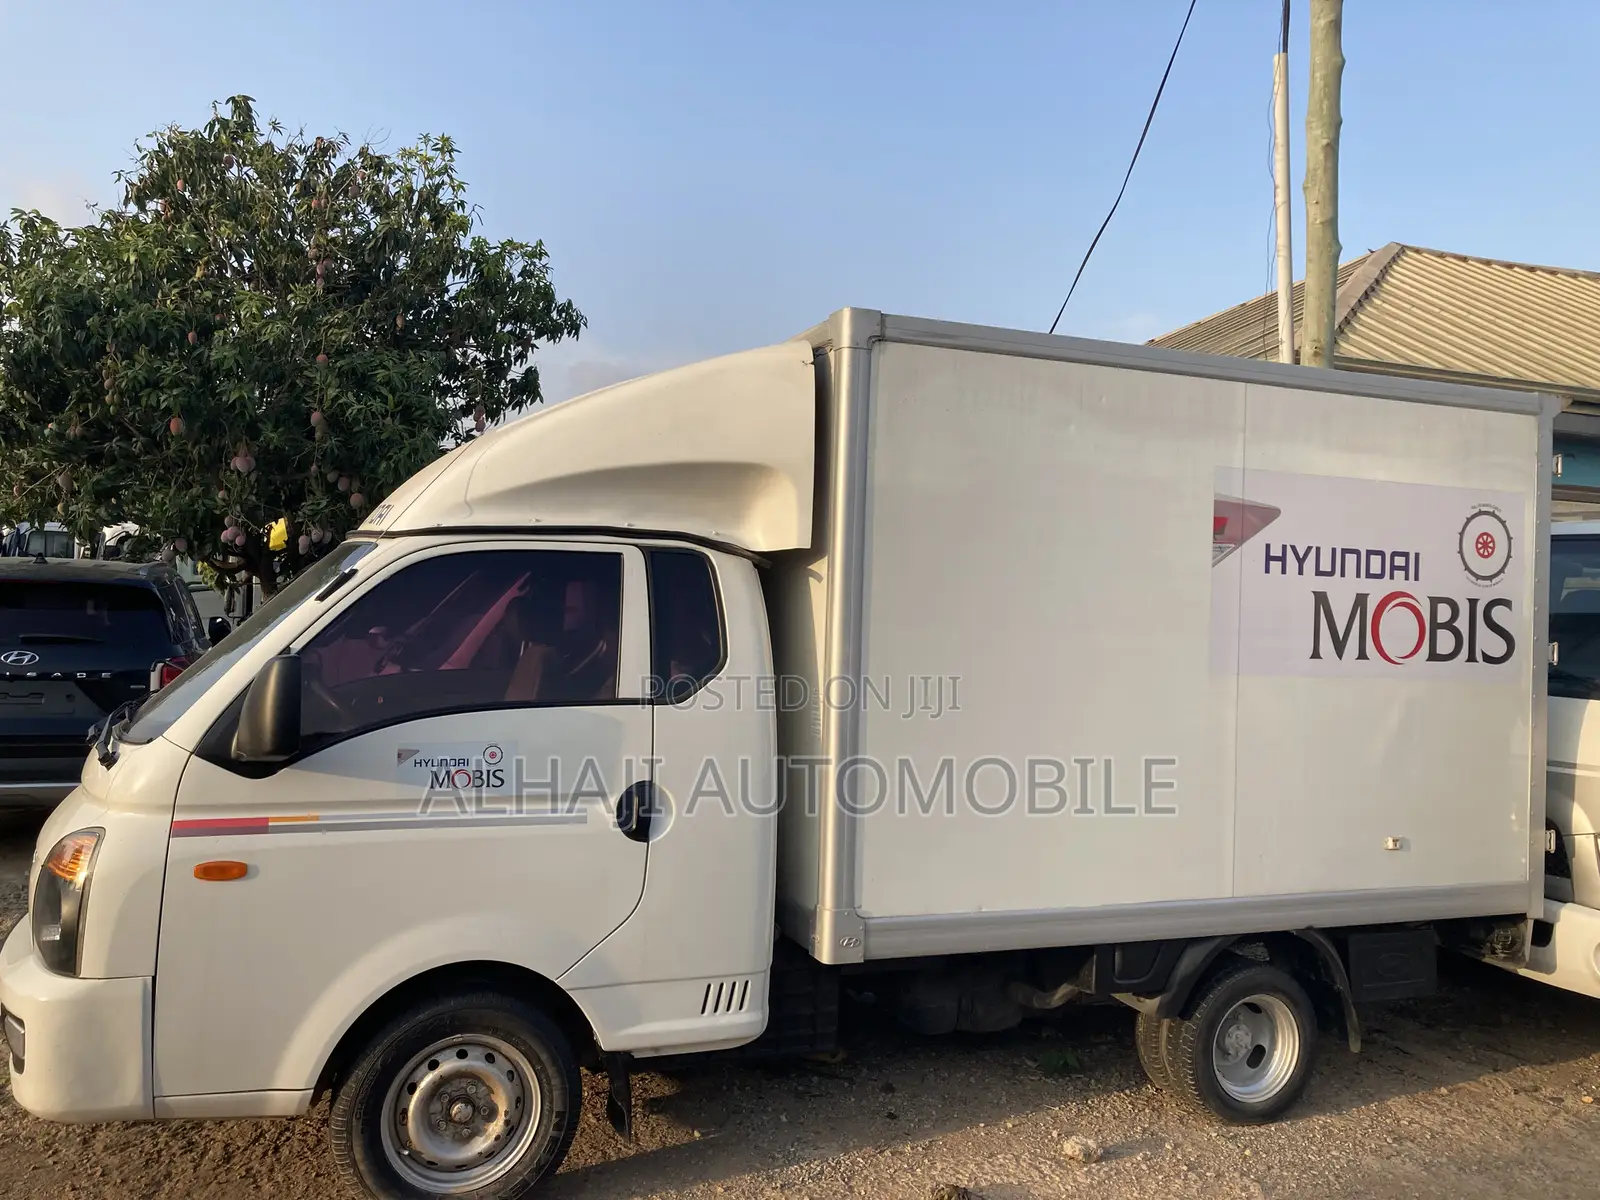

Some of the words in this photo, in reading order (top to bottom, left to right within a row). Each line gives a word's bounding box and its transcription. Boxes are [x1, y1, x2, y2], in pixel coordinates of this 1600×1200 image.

[1264, 543, 1420, 581] HYUNDAI
[1309, 590, 1516, 666] MOBIS
[414, 758, 469, 768] HYUNDAI
[430, 769, 505, 790] MOBIS
